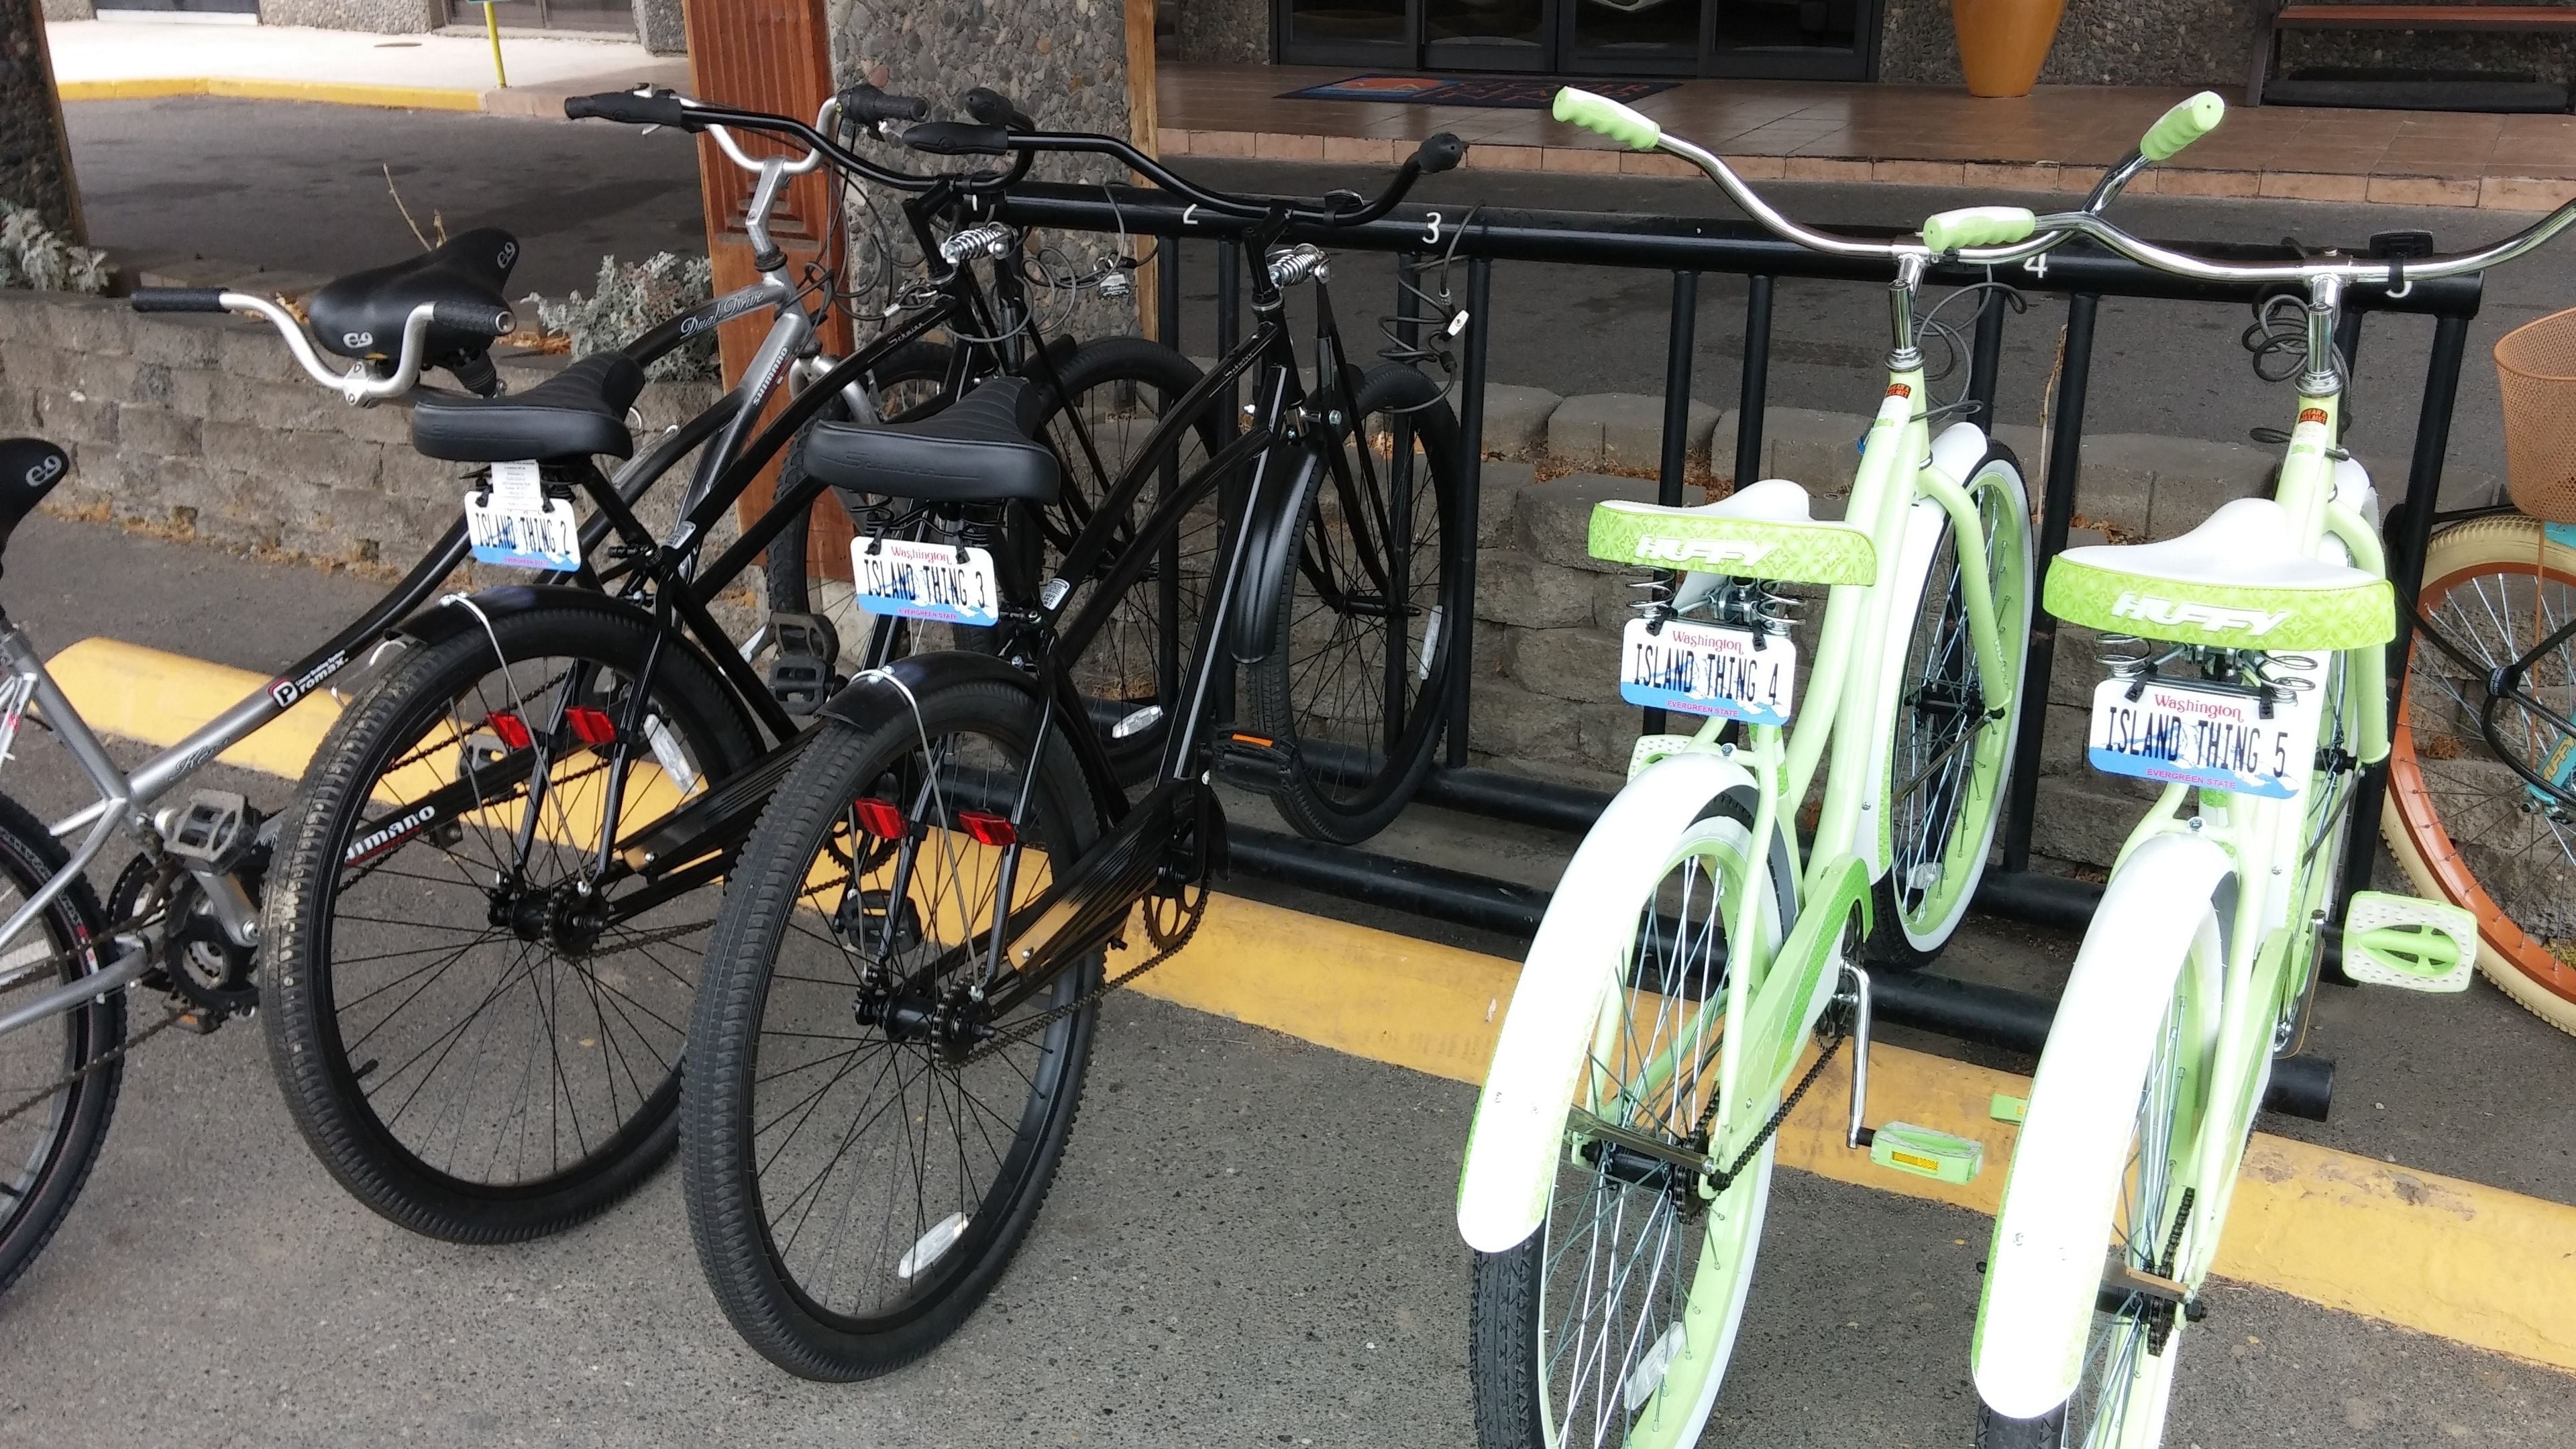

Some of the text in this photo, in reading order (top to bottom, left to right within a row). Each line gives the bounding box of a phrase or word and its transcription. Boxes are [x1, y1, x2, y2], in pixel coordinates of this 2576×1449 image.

[1422, 211, 1442, 244] 3
[2023, 252, 2048, 278] 4
[680, 290, 763, 339] Dual-Drive
[753, 345, 788, 407] SHIMANO
[2300, 415, 2326, 423] HELMET
[476, 513, 571, 555] ISLAND THING 2
[891, 546, 953, 566] Washington
[1634, 535, 1778, 568] HUFFY
[864, 559, 986, 608] ISLAND THING 3
[898, 607, 958, 620] EVERGREEN STATE
[2110, 590, 2292, 637] HUFFY
[1672, 630, 1744, 655] Washington
[1633, 643, 1779, 706] ISLAND THING 4
[1667, 700, 1739, 717] EVERGREEN STATE
[2154, 694, 2244, 723] Washington
[2105, 706, 2289, 778] ISLAND THING 5
[2146, 768, 2237, 790] EVERGREEN STATE
